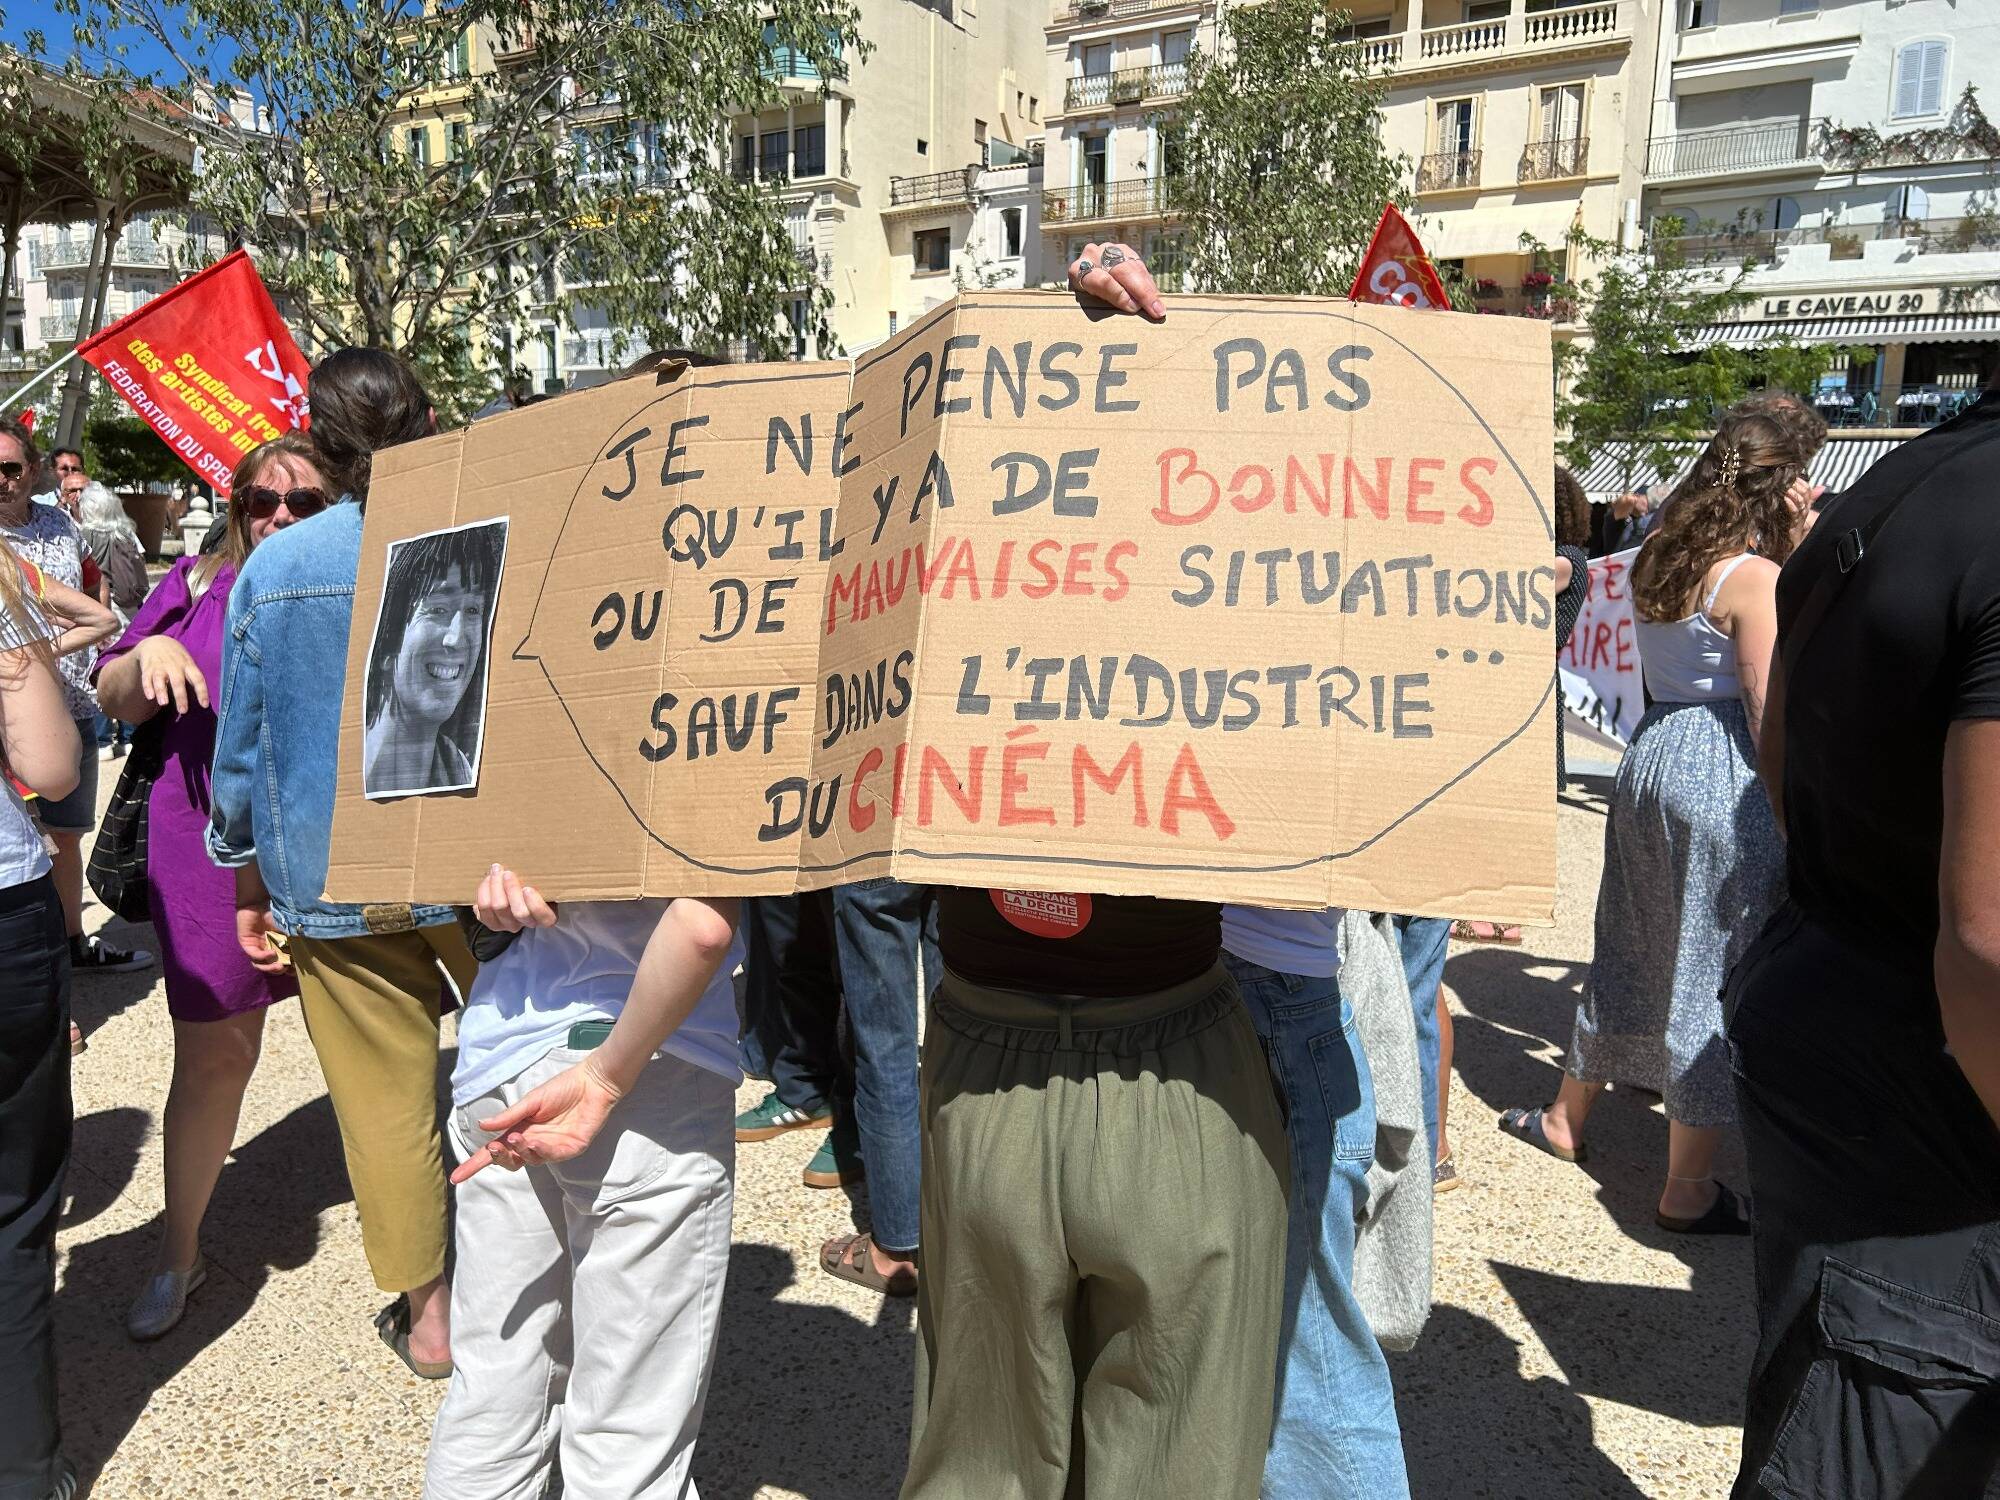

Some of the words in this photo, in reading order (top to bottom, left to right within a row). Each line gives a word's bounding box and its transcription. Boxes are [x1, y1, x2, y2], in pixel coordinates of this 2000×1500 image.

[1764, 300, 1790, 318] LE
[1796, 295, 1891, 317] CAVEAU
[1897, 294, 1923, 312] 30
[103, 360, 183, 440] FÉDÉRATION
[176, 435, 203, 459] DU
[127, 339, 163, 373] des
[160, 371, 233, 434] artistes
[174, 353, 252, 418] Syndicat
[602, 415, 710, 502] JE
[765, 401, 864, 478] NE
[900, 334, 1140, 439] PENSE
[1213, 338, 1374, 413] PAS
[662, 504, 845, 570] QU'IL
[991, 448, 1100, 517] DE
[1151, 447, 1498, 526] BONNES
[591, 591, 663, 650] OU
[700, 577, 798, 643] DE
[826, 536, 1138, 635] MAUVAISES
[1171, 545, 1555, 630] SITUATIONS
[639, 687, 800, 761] SAUF
[822, 649, 914, 749] DANS
[758, 774, 842, 842] DU
[848, 725, 1235, 841] CINÉMA
[1004, 893, 1023, 906] LA
